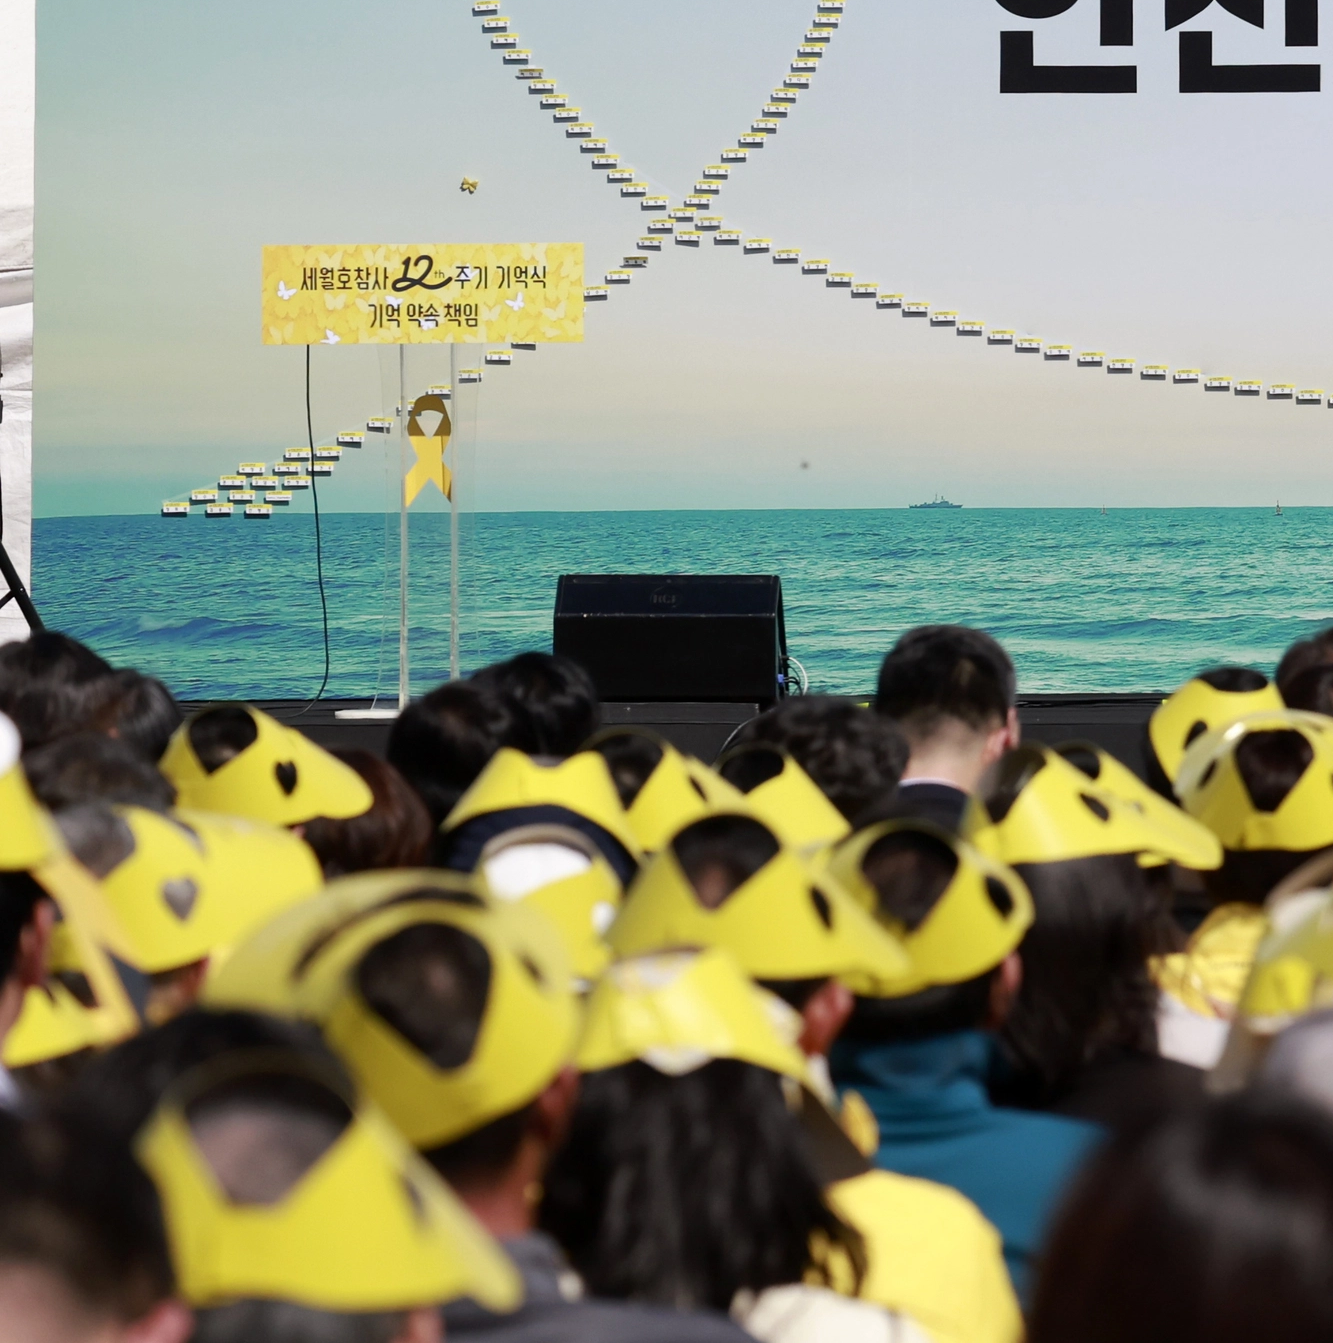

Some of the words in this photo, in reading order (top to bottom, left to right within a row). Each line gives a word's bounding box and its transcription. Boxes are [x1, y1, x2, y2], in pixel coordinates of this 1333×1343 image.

[497, 266, 546, 290] 기억식
[369, 303, 401, 328] 기억
[407, 303, 440, 327] 약속
[444, 303, 478, 328] 책임
